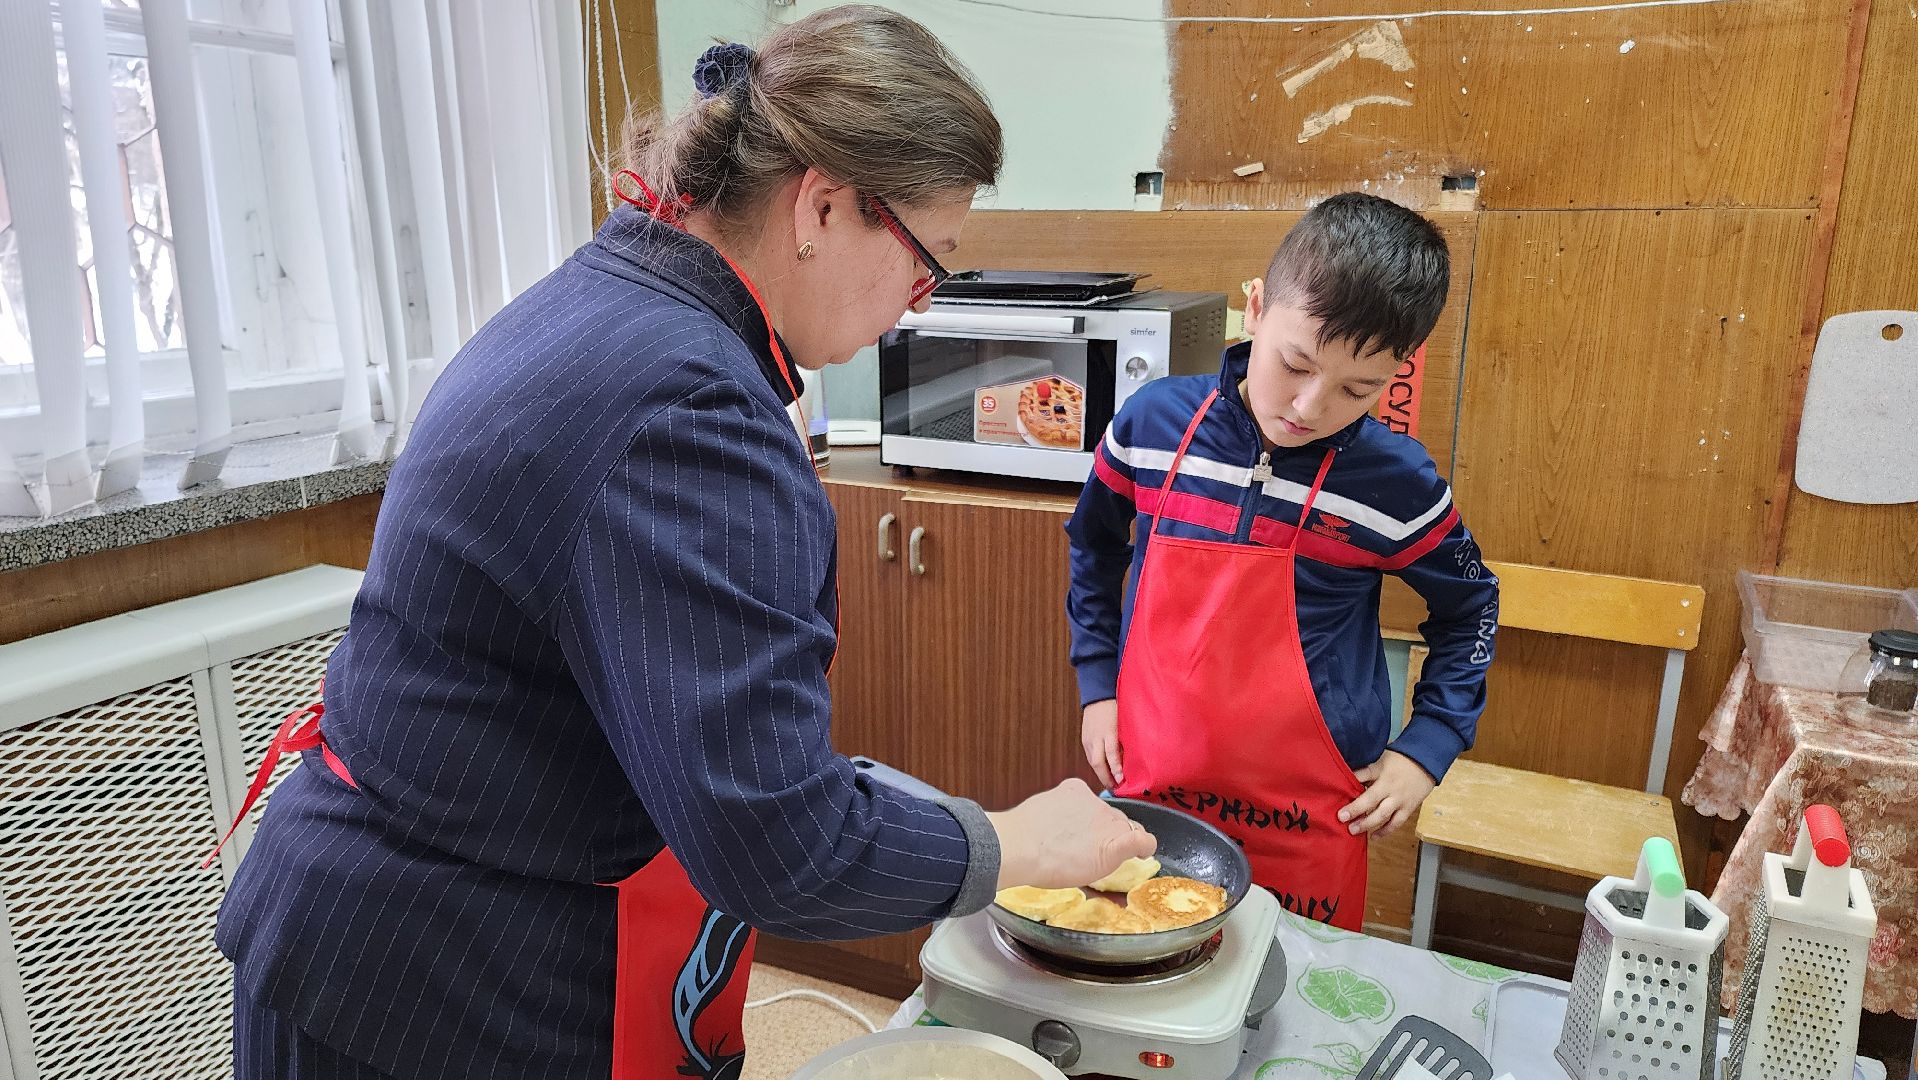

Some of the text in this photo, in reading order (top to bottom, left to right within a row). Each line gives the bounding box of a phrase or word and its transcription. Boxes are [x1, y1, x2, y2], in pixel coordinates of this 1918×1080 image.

[1130, 327, 1157, 336] simfer
[982, 399, 996, 408] 35
[1381, 353, 1415, 435] ОСУД
[1143, 785, 1310, 834] ЁРНЫЙ
